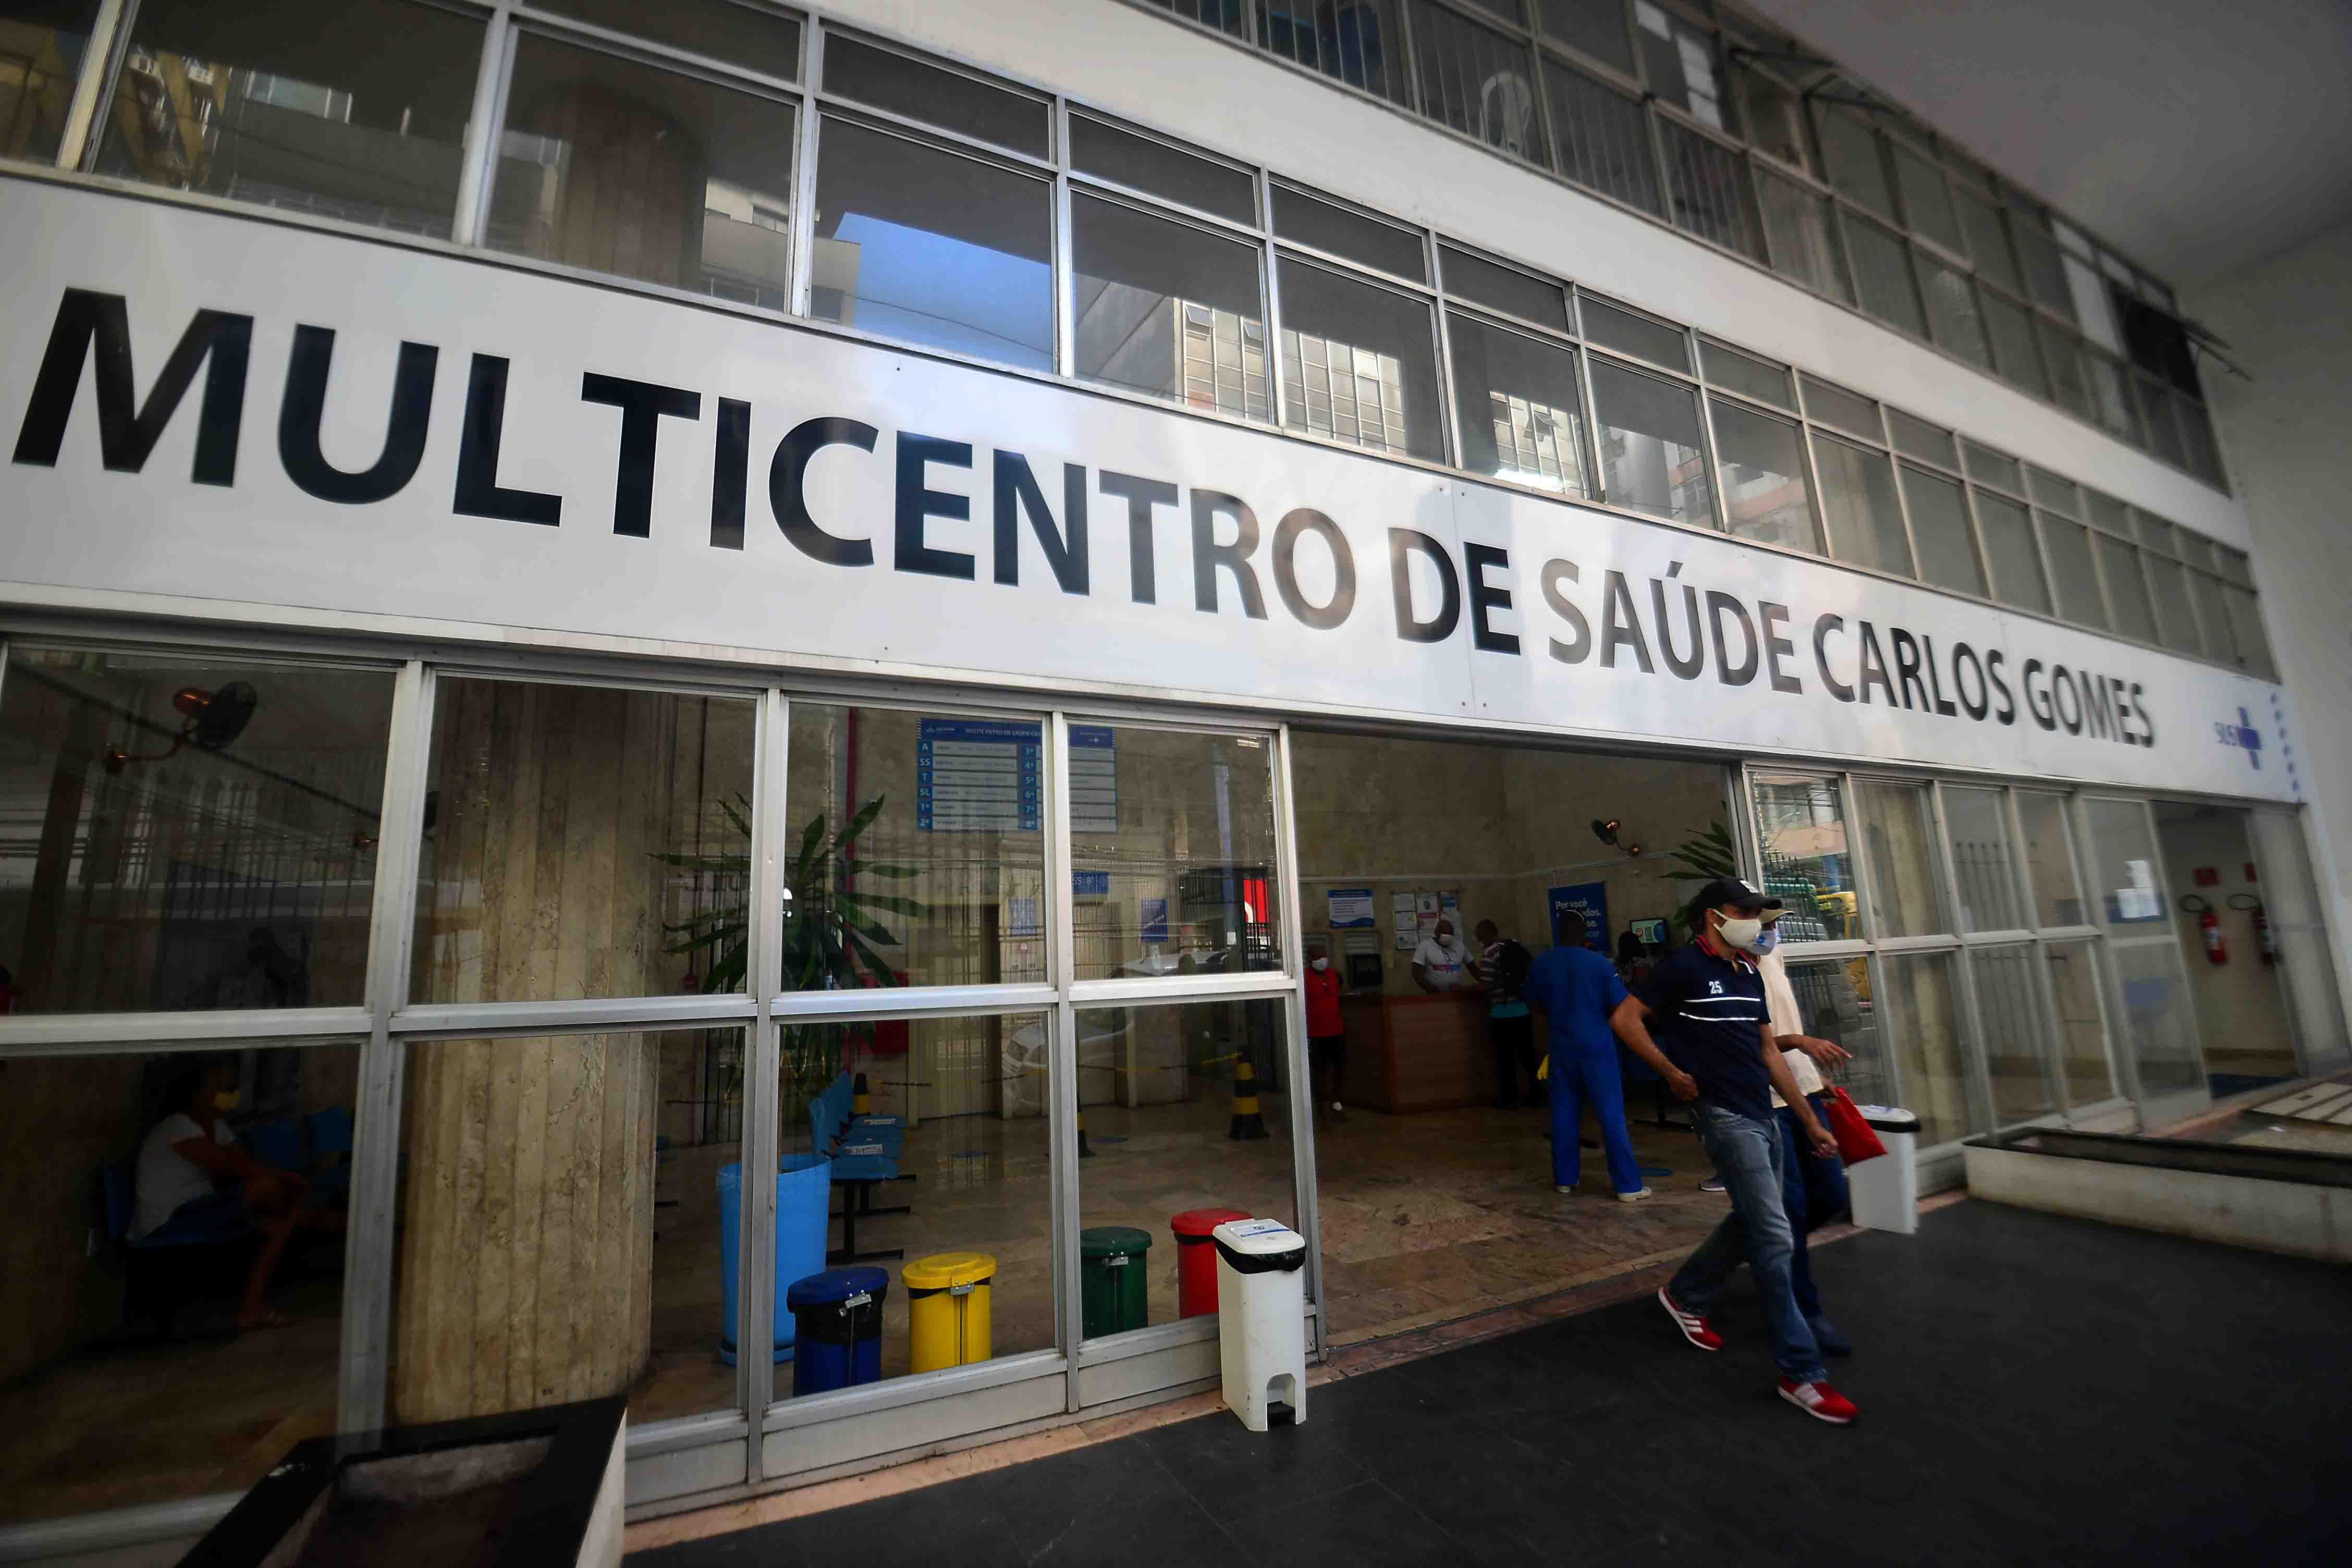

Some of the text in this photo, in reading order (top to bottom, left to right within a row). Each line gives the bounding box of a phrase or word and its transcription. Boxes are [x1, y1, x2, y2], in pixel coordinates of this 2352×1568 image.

[12, 286, 2154, 748] MULTICENTRO DE SAÚDE CARLOS GOMES
[1555, 897, 1588, 910] Por você
[1709, 981, 1723, 994] 25
